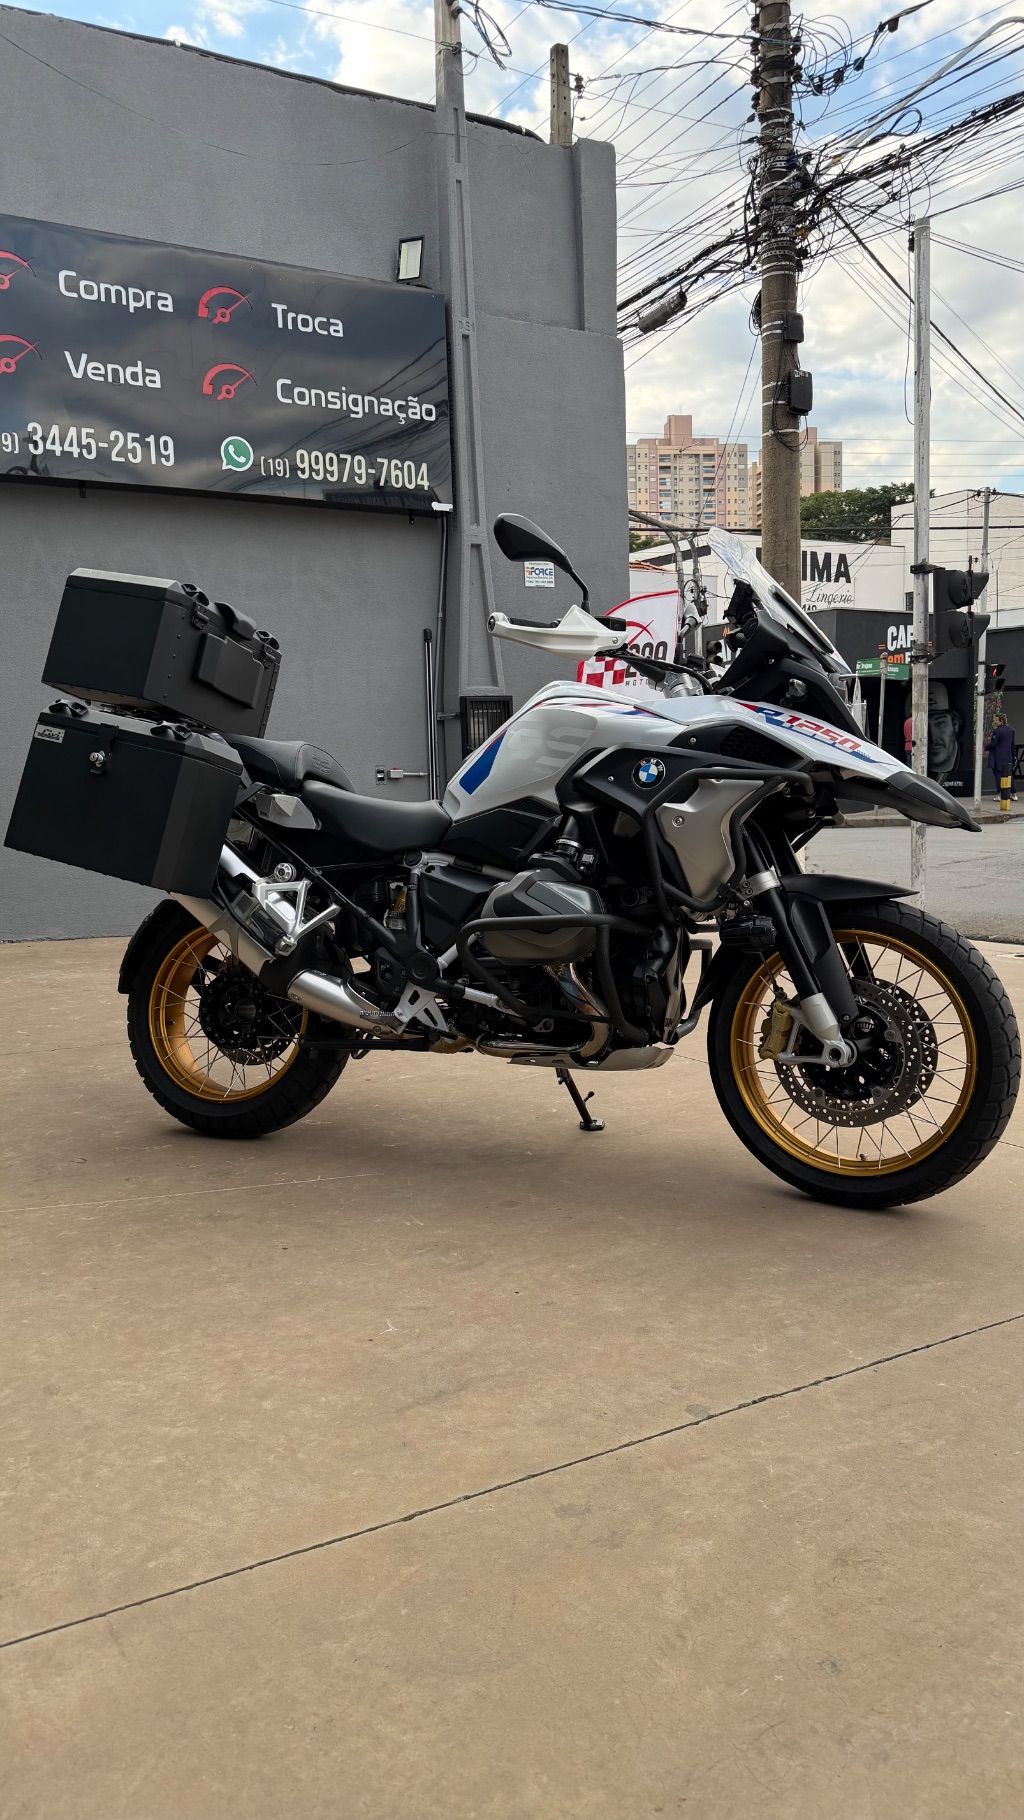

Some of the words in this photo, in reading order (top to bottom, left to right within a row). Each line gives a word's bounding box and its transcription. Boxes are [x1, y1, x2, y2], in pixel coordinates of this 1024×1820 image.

[58, 269, 174, 313] Compra
[270, 303, 344, 338] Troca
[63, 350, 162, 389] Venda
[275, 378, 437, 425] Consignação
[27, 421, 175, 467] 3445-2519
[260, 454, 290, 478] (19)
[296, 448, 430, 491] 99979-7604
[806, 584, 855, 606] Lingerie
[887, 624, 914, 652] CAF
